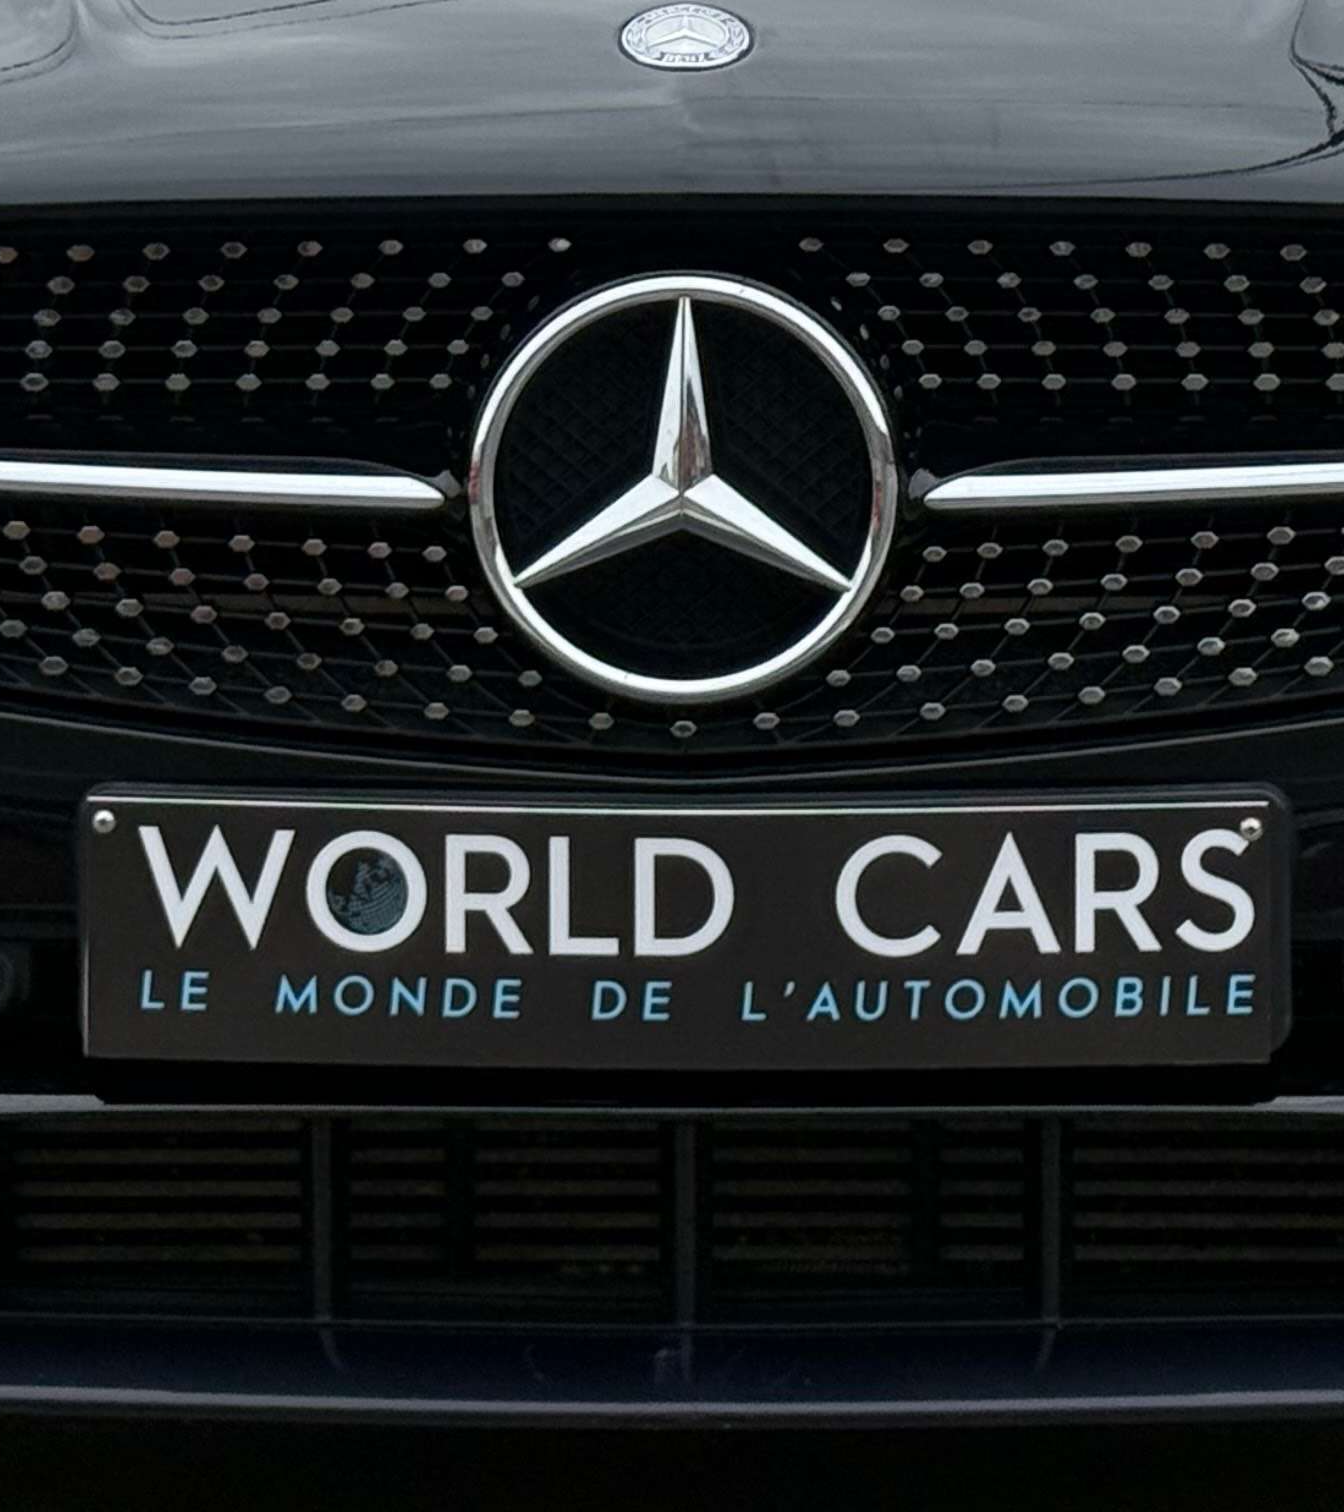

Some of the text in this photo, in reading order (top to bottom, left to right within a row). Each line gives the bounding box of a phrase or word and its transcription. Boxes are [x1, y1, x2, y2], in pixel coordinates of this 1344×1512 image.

[137, 823, 1256, 958] WORLD CARS
[138, 969, 1256, 1022] LE MONDE DE L'AUTOMOBILE
